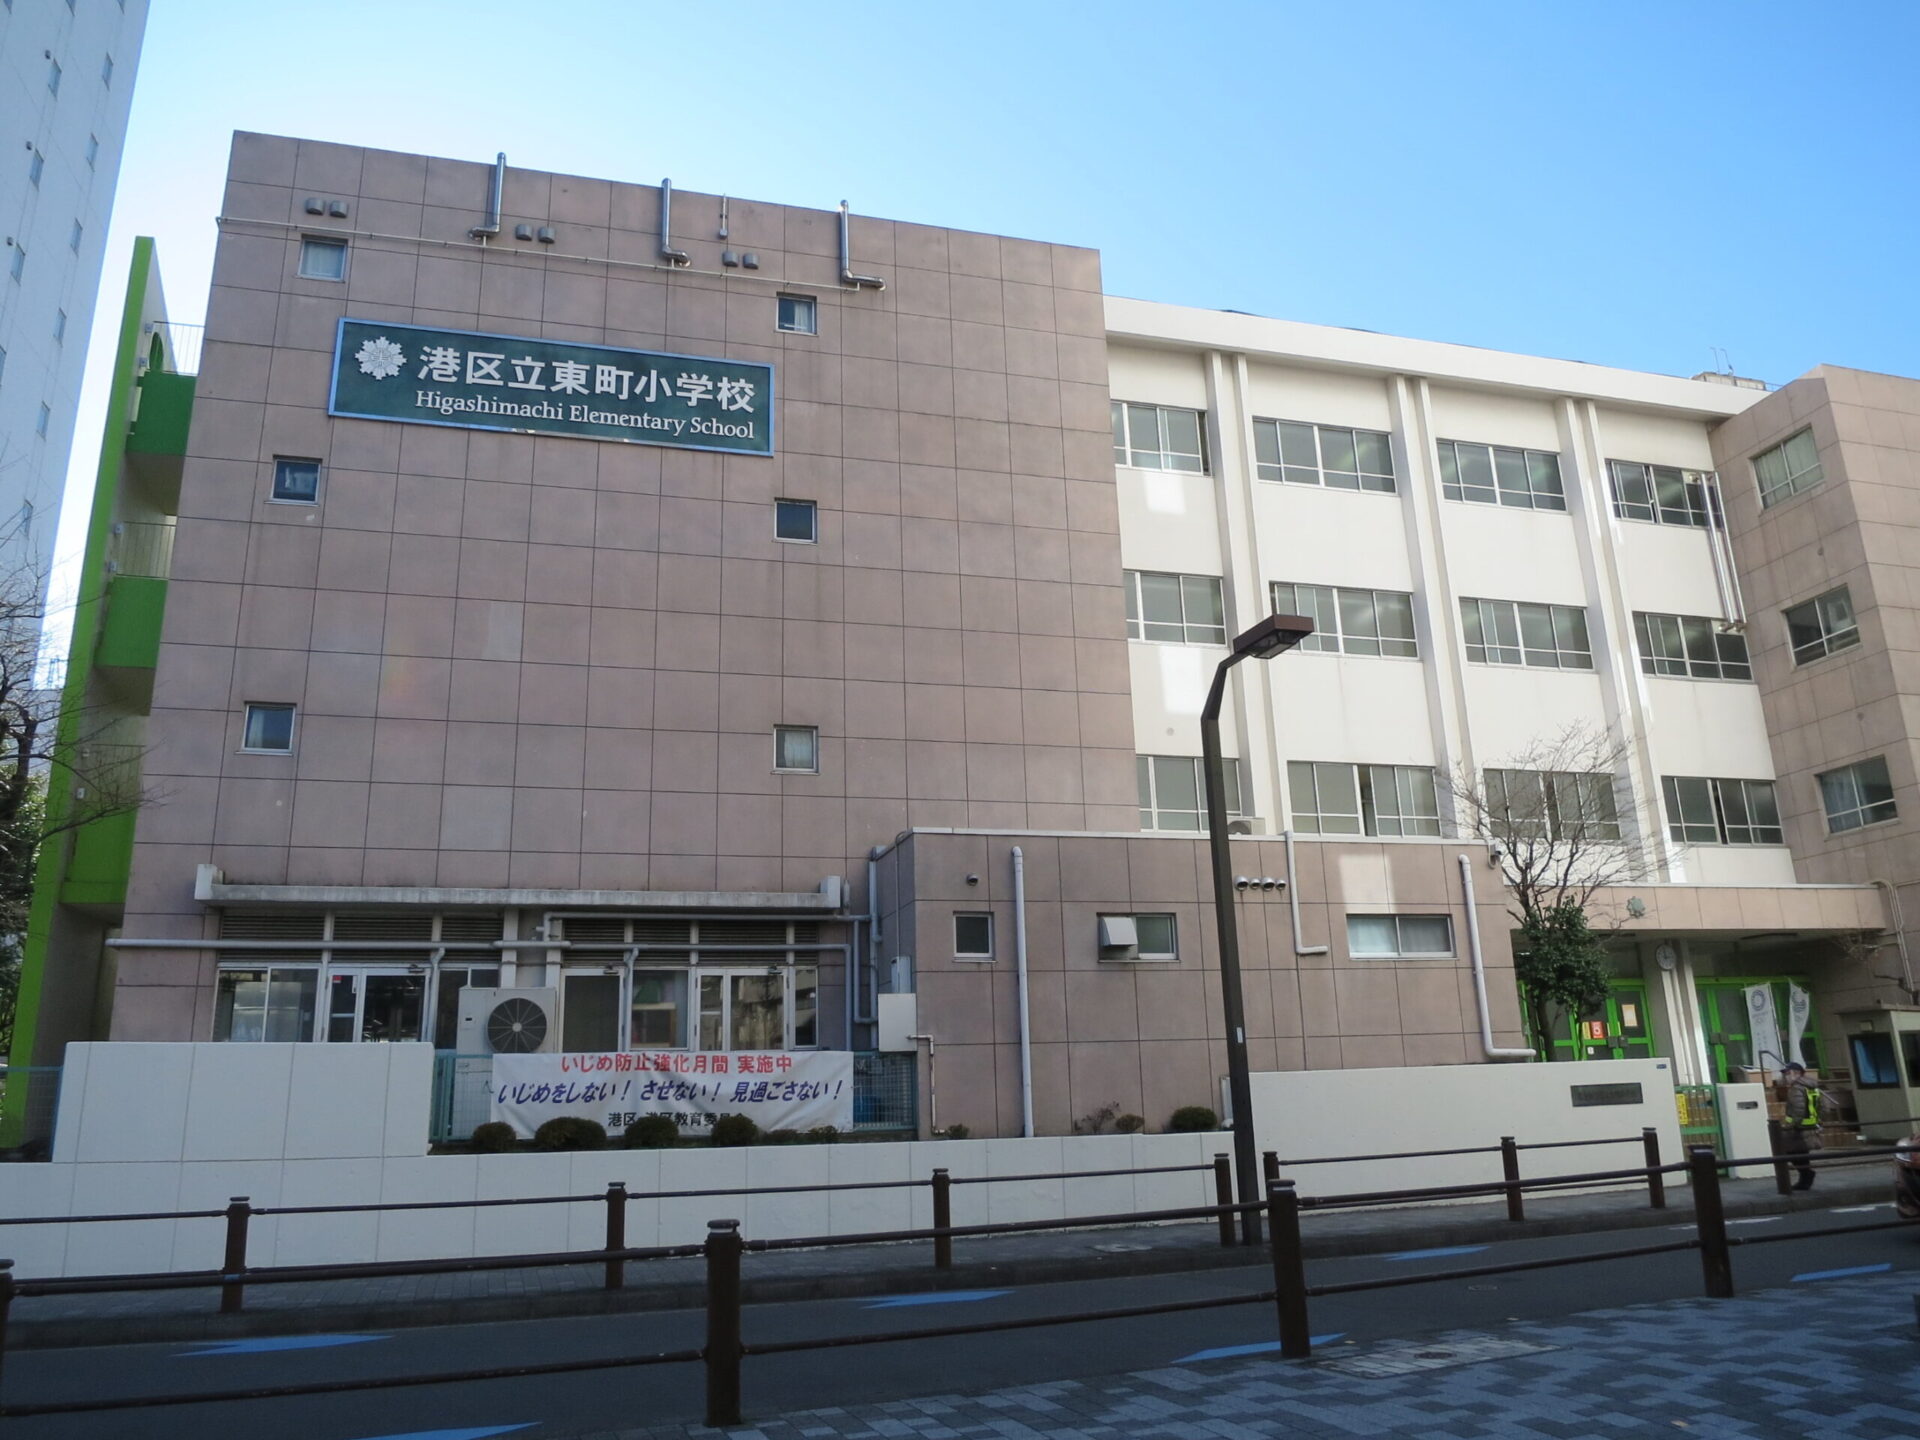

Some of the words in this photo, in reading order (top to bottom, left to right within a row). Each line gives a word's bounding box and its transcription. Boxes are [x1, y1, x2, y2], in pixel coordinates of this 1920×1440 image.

[417, 345, 755, 413] 港区立東町小学校
[415, 390, 564, 420] Higashimachi
[569, 405, 687, 436] Elementary
[690, 417, 755, 439] School
[562, 1053, 728, 1073] いじめ防止強化月間
[737, 1055, 792, 1073] 実施中
